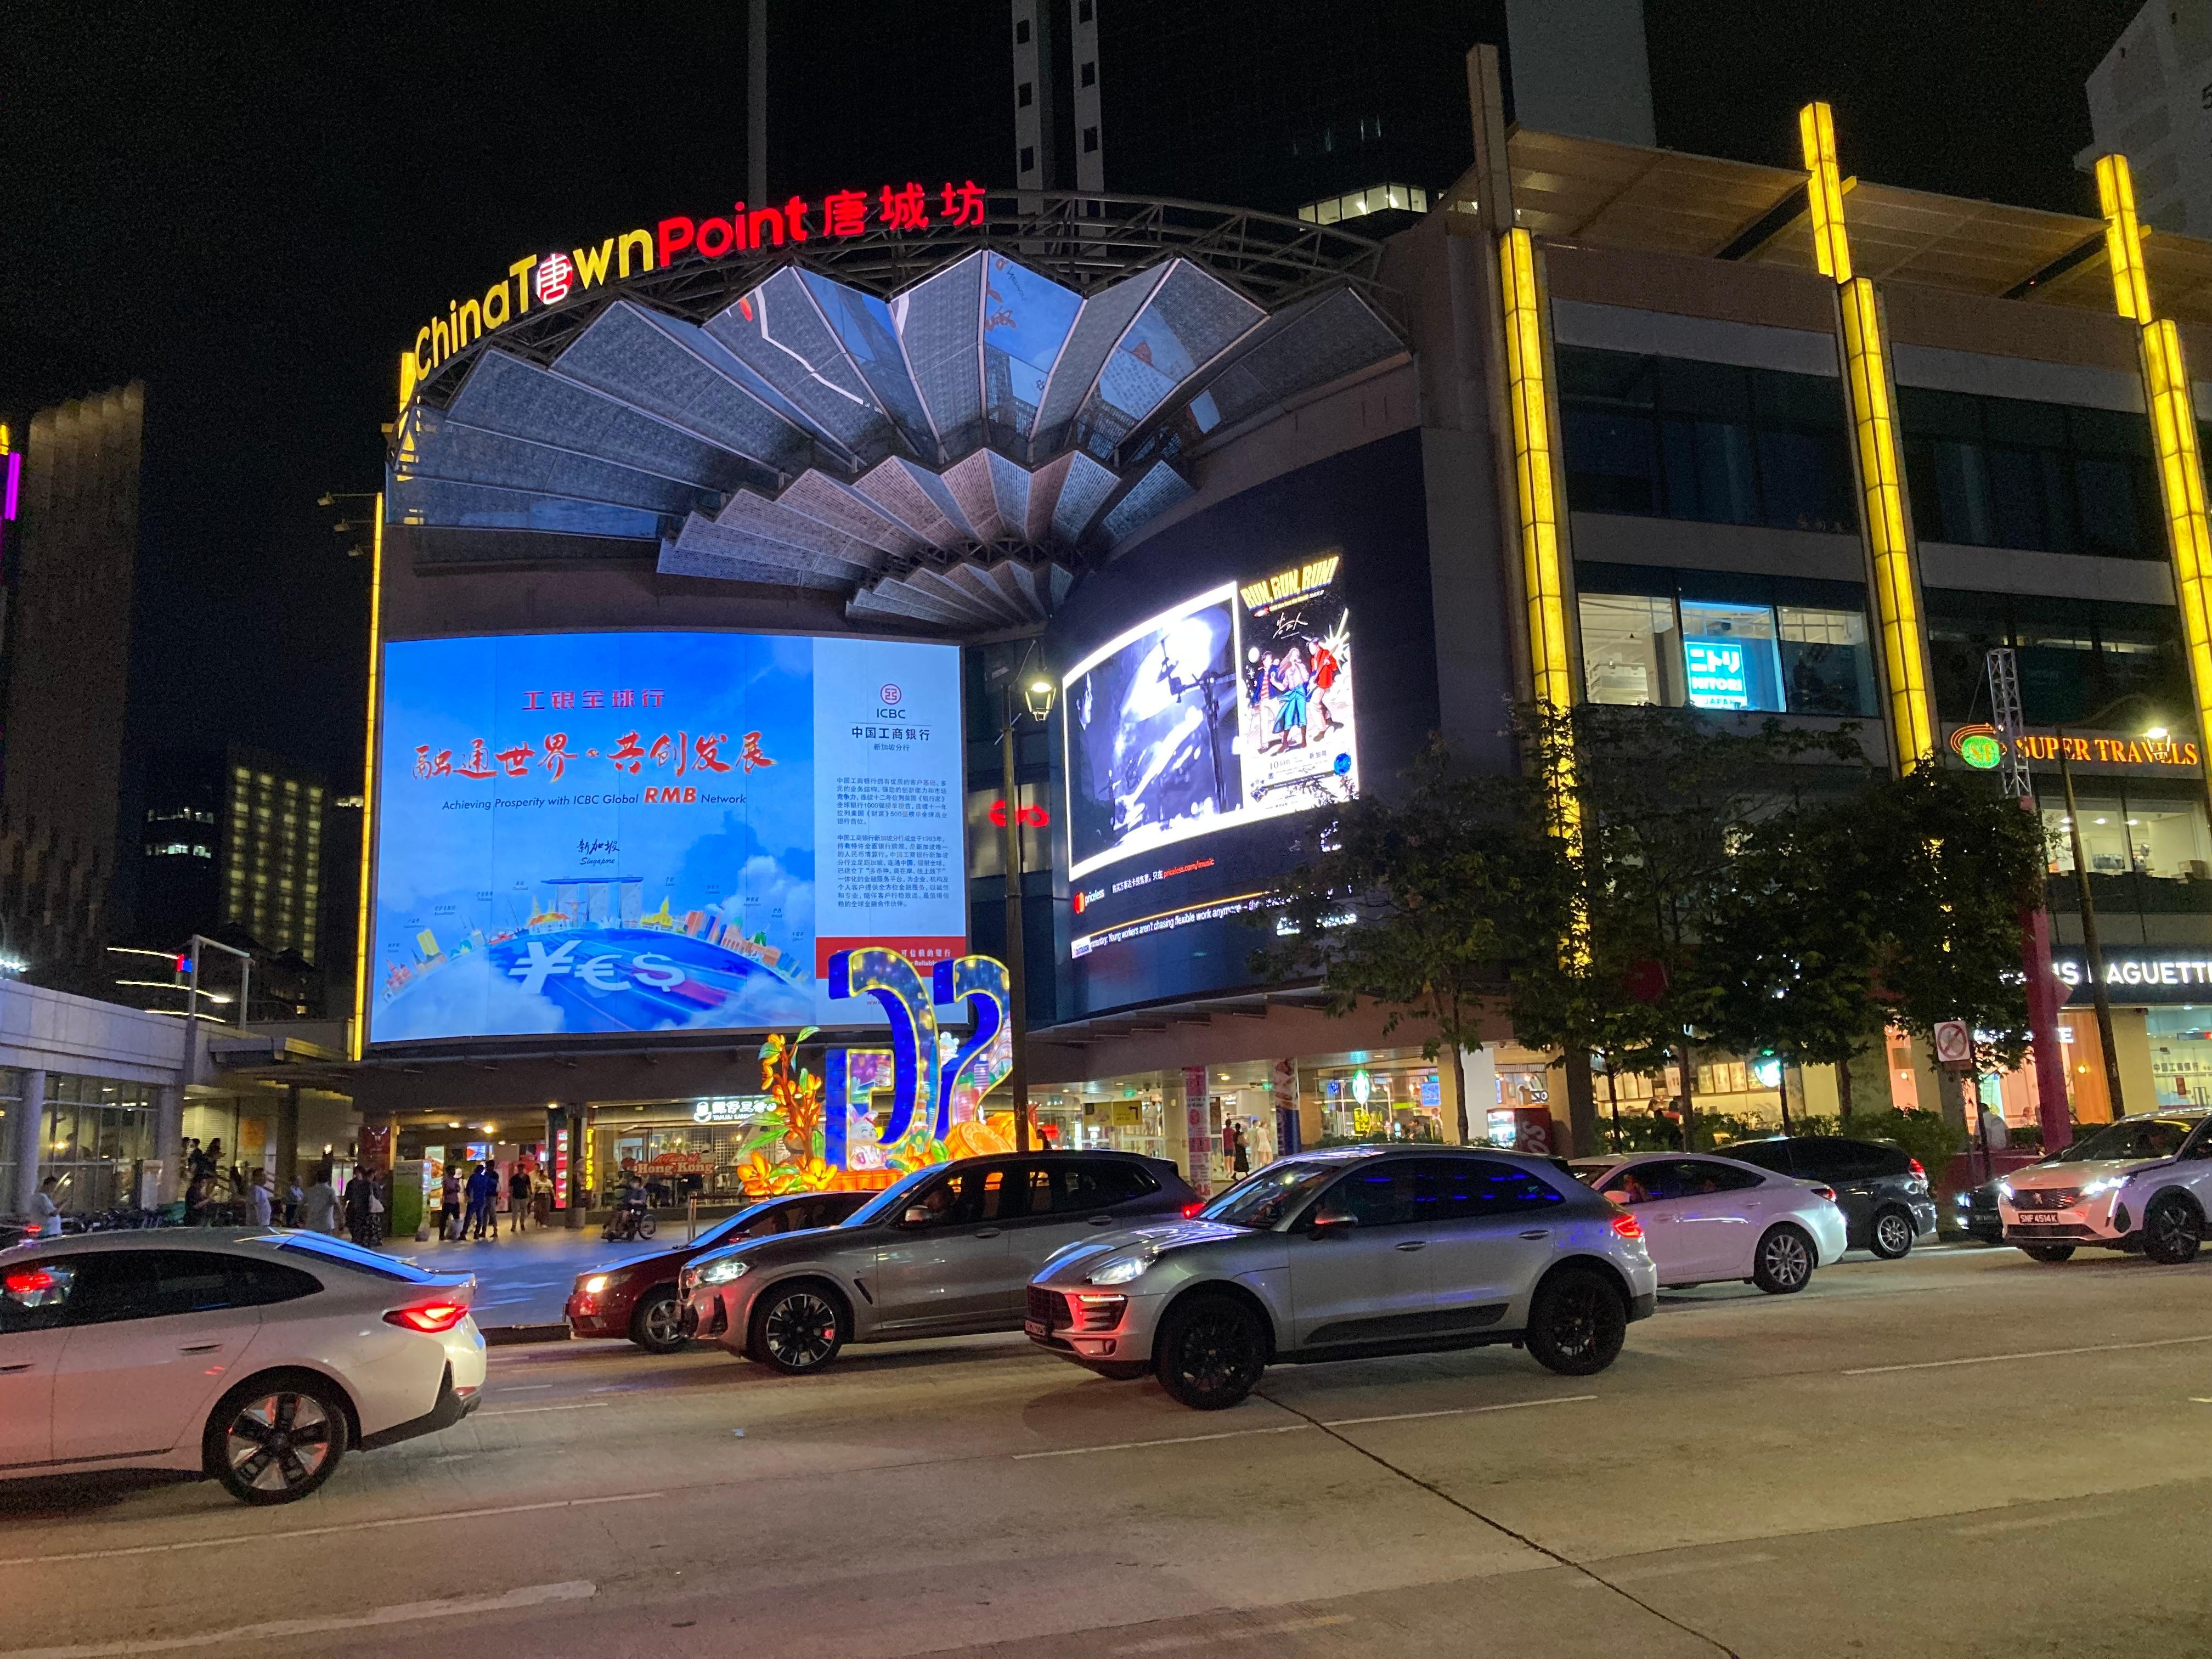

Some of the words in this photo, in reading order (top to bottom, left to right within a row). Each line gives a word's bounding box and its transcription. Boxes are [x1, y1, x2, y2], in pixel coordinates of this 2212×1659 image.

[823, 180, 985, 236] 唐城坊
[1301, 556, 1339, 592] RUN!
[1690, 649, 1740, 674] ニトリ
[1691, 676, 1743, 691] NITORI
[522, 689, 665, 711] 工银全球行
[877, 708, 906, 719] ICBC
[852, 726, 930, 741] 中国工商银行
[873, 743, 910, 752] 新加坡分行
[442, 800, 492, 810] Achieving
[495, 798, 545, 808] Prosperity
[549, 795, 569, 805] with
[574, 794, 599, 804] ICBC
[603, 794, 638, 804] Global
[644, 787, 696, 804] RMB
[701, 794, 746, 804] Network
[577, 838, 620, 855] 新加坡
[580, 857, 615, 866] Singapore
[1164, 858, 1215, 879] priceless.com/music
[1085, 889, 1104, 906] priceless
[1108, 932, 1121, 943] Young
[1121, 927, 1139, 939] workers
[1154, 917, 1174, 931] chasing
[1175, 912, 1195, 926] flexible
[1196, 907, 1211, 919] work
[2087, 960, 2212, 985] AGUETT
[637, 1164, 674, 1175] Hong
[677, 1162, 714, 1173] Kong
